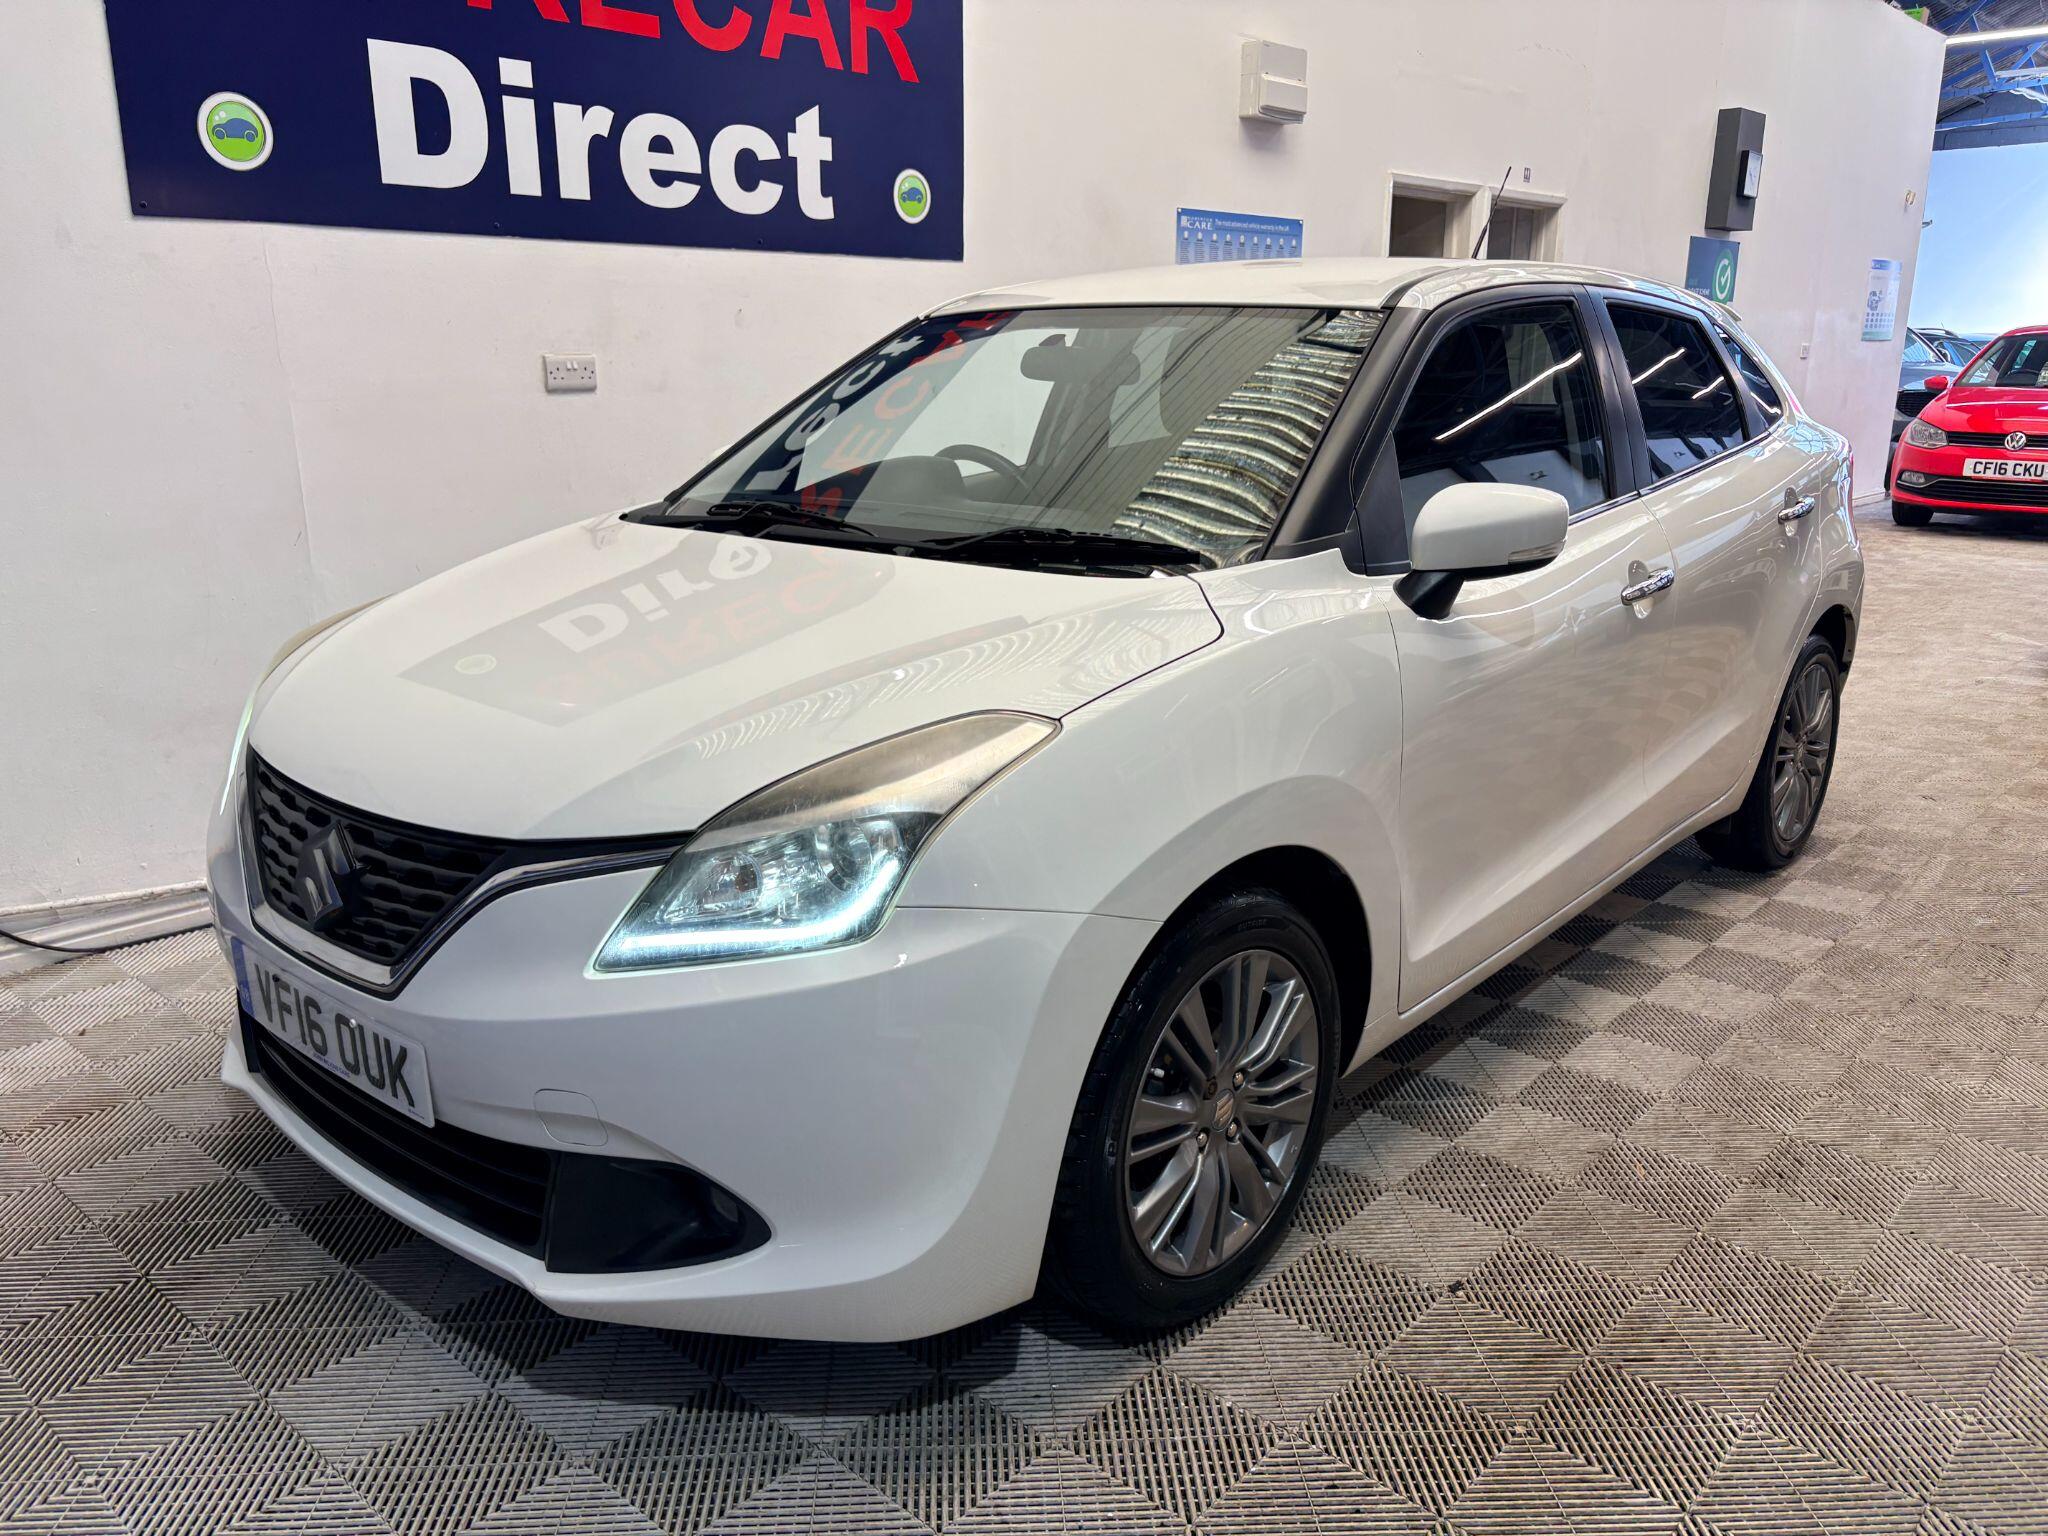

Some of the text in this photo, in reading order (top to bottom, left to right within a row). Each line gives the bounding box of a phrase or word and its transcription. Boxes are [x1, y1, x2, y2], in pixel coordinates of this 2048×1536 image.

[366, 38, 835, 220] Direct
[1187, 220, 1213, 231] CARE
[1973, 461, 2045, 478] CF16 CKU
[254, 963, 416, 1108] VF16 OUK
